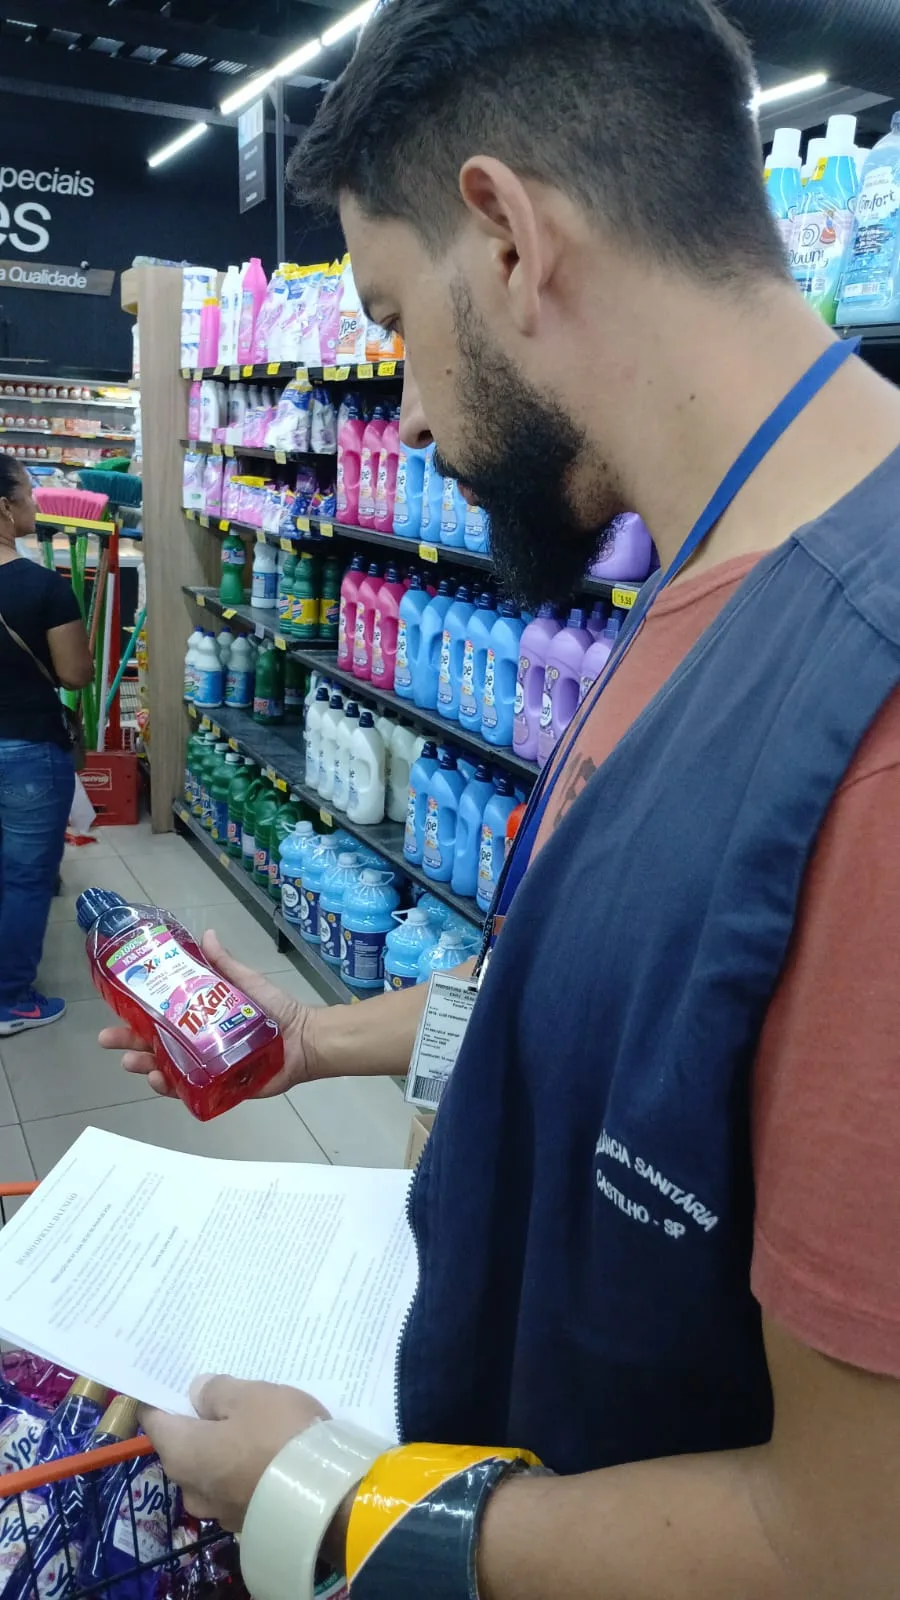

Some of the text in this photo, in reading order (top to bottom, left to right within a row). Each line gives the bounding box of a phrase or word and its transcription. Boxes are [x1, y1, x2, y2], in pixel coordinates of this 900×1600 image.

[0, 201, 52, 253] s
[9, 266, 88, 288] Qualidade
[596, 1168, 650, 1223] CASTILHO
[663, 1218, 686, 1239] SP
